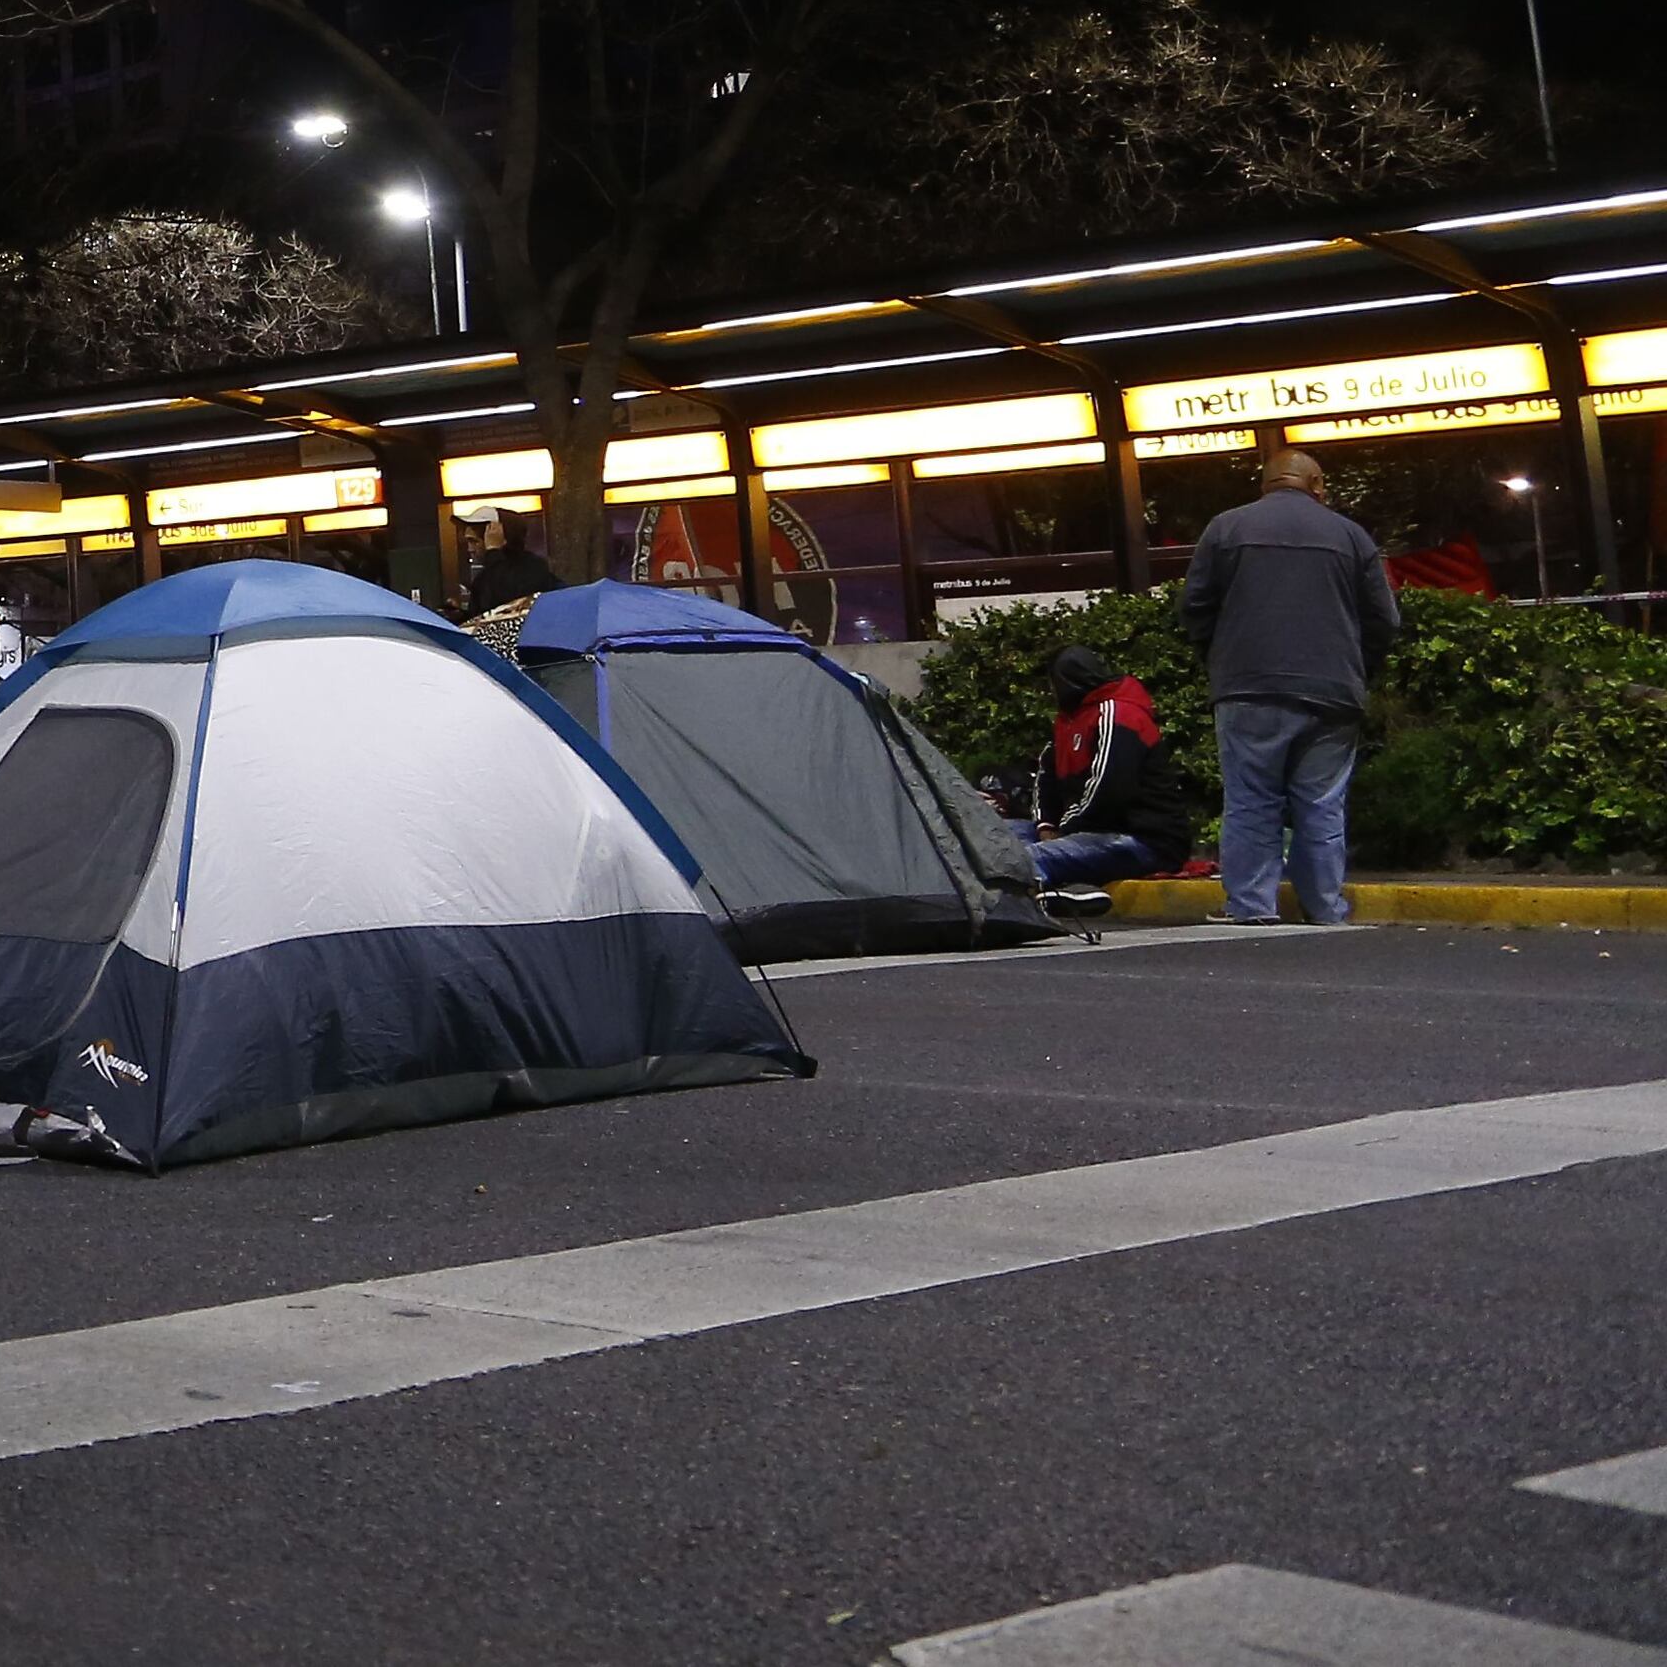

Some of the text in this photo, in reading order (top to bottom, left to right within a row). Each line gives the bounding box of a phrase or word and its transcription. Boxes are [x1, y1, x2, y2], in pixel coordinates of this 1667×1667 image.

[1344, 378, 1359, 400] 9
[1370, 375, 1403, 397] de
[1416, 366, 1487, 393] Julio
[341, 477, 376, 503] 129
